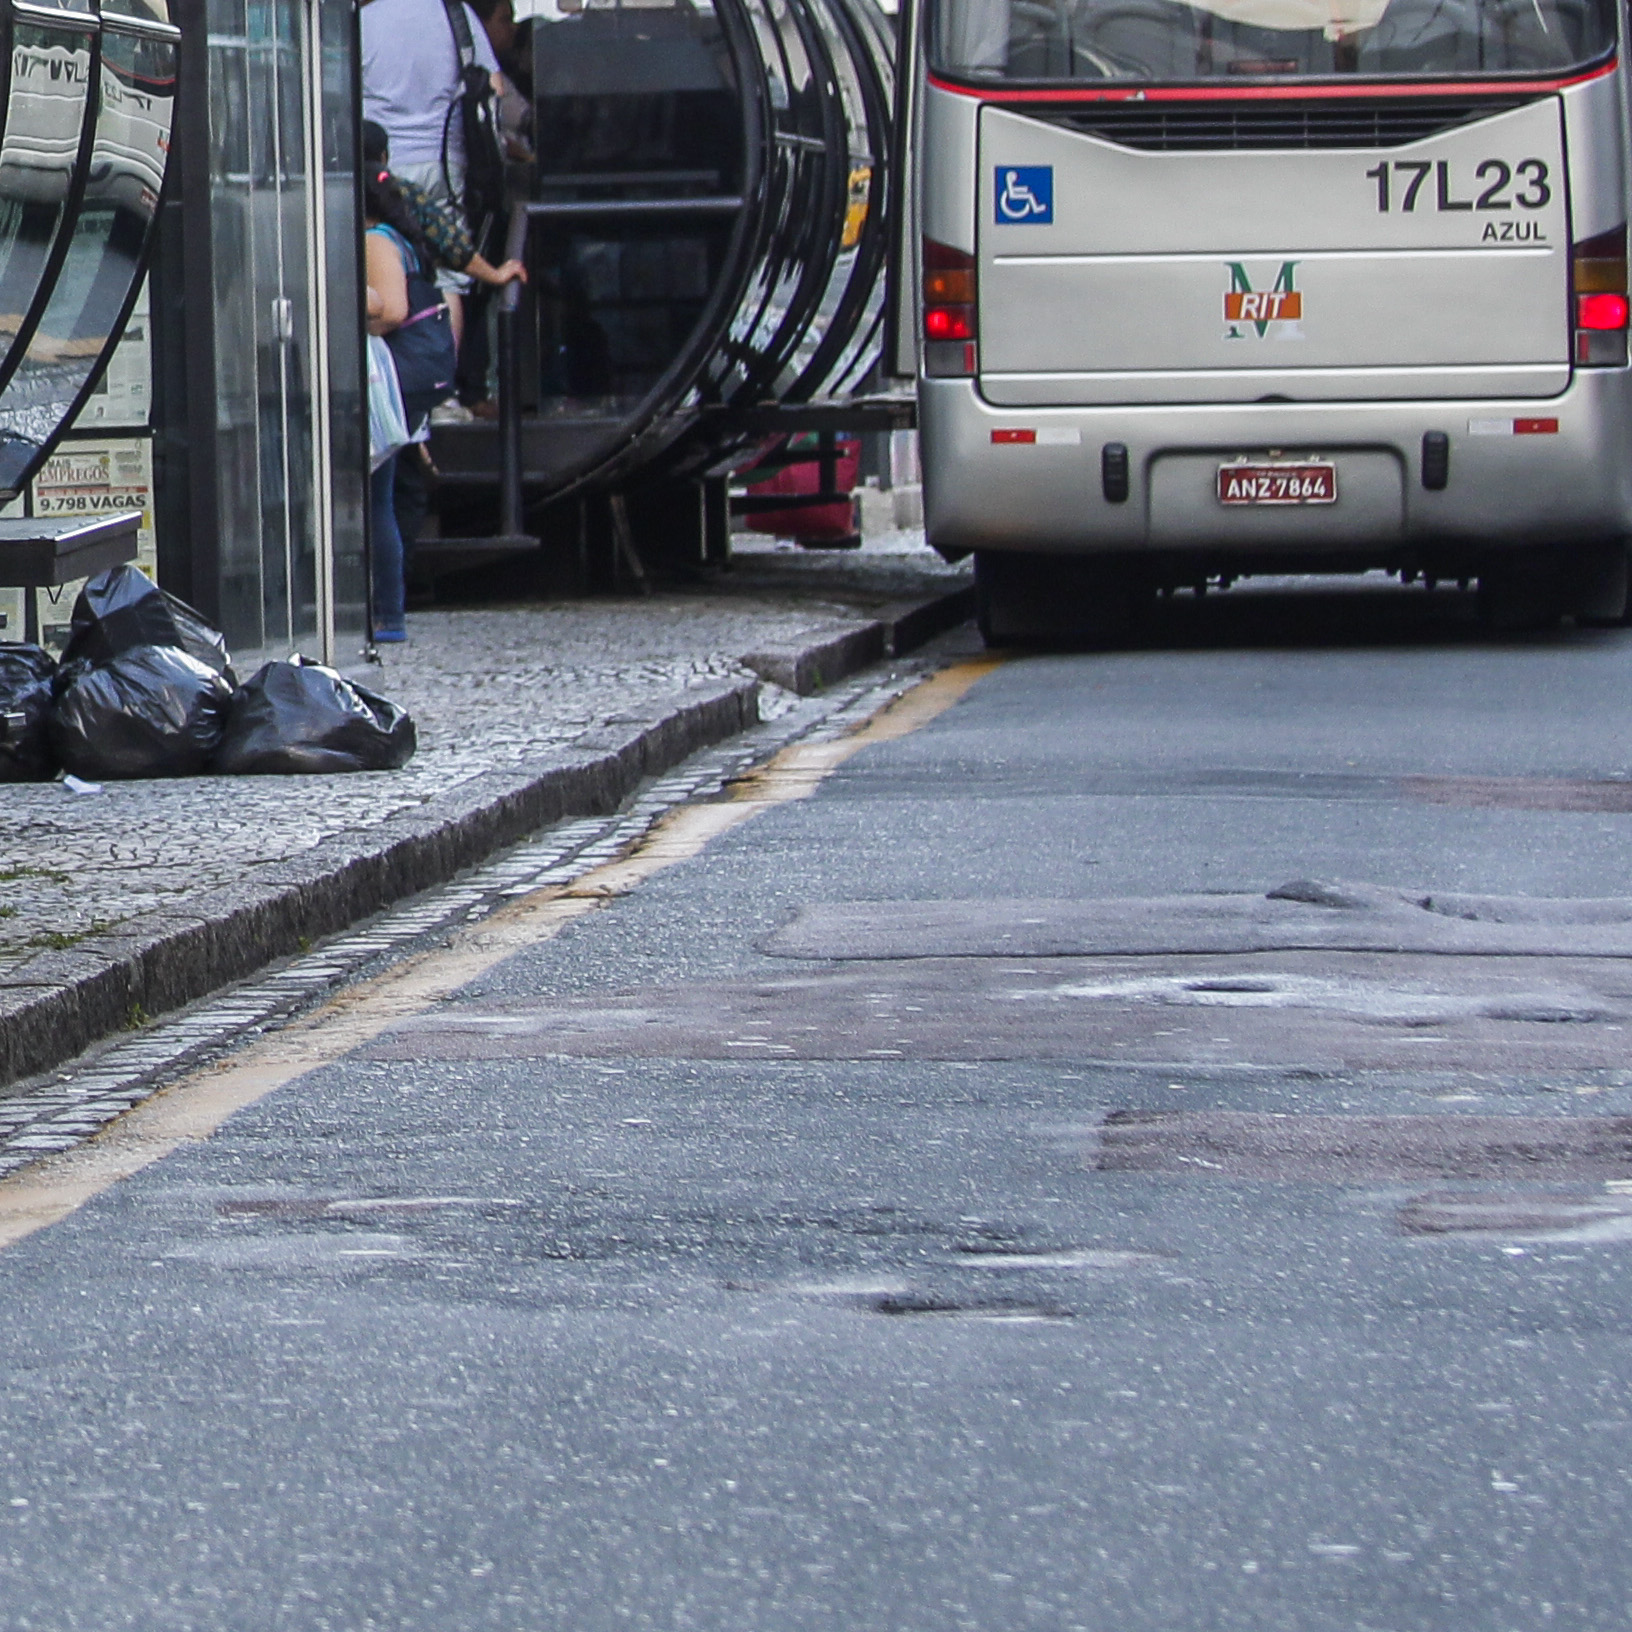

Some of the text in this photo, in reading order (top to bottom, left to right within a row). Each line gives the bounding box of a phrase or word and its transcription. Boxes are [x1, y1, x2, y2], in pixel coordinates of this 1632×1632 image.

[1366, 158, 1551, 213] 17L23
[1482, 222, 1546, 242] AZUL
[1239, 293, 1287, 319] RIT
[39, 466, 110, 483] EMPREGOS
[40, 494, 147, 511] 9.798 VAGAS
